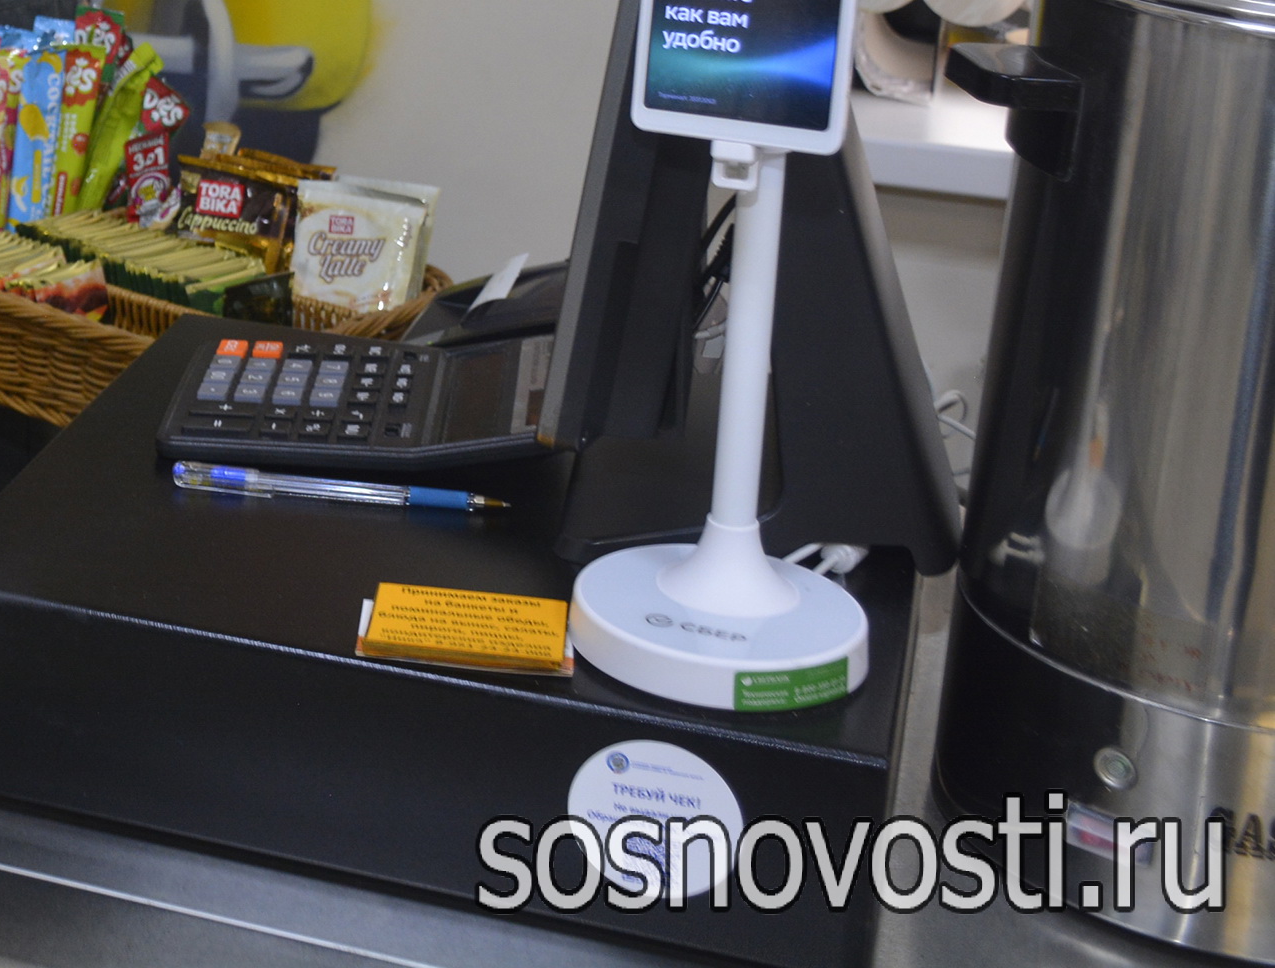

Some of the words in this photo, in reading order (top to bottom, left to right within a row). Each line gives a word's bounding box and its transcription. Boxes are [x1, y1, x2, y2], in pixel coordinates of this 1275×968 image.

[664, 5, 704, 23] как
[707, 9, 750, 29] вам
[662, 30, 742, 53] удобно
[199, 182, 243, 201] TORA
[198, 197, 239, 215] BIKA
[177, 206, 259, 235] Cappuccino
[308, 231, 386, 263] Creamy
[319, 254, 367, 284] Latte
[401, 586, 487, 602] Принимаем
[492, 596, 540, 607] заказы
[444, 600, 505, 613] банкеты
[680, 621, 747, 642] СБЕР
[612, 782, 665, 803] ТРЕБУЙ
[669, 792, 702, 810] ЧЕК!
